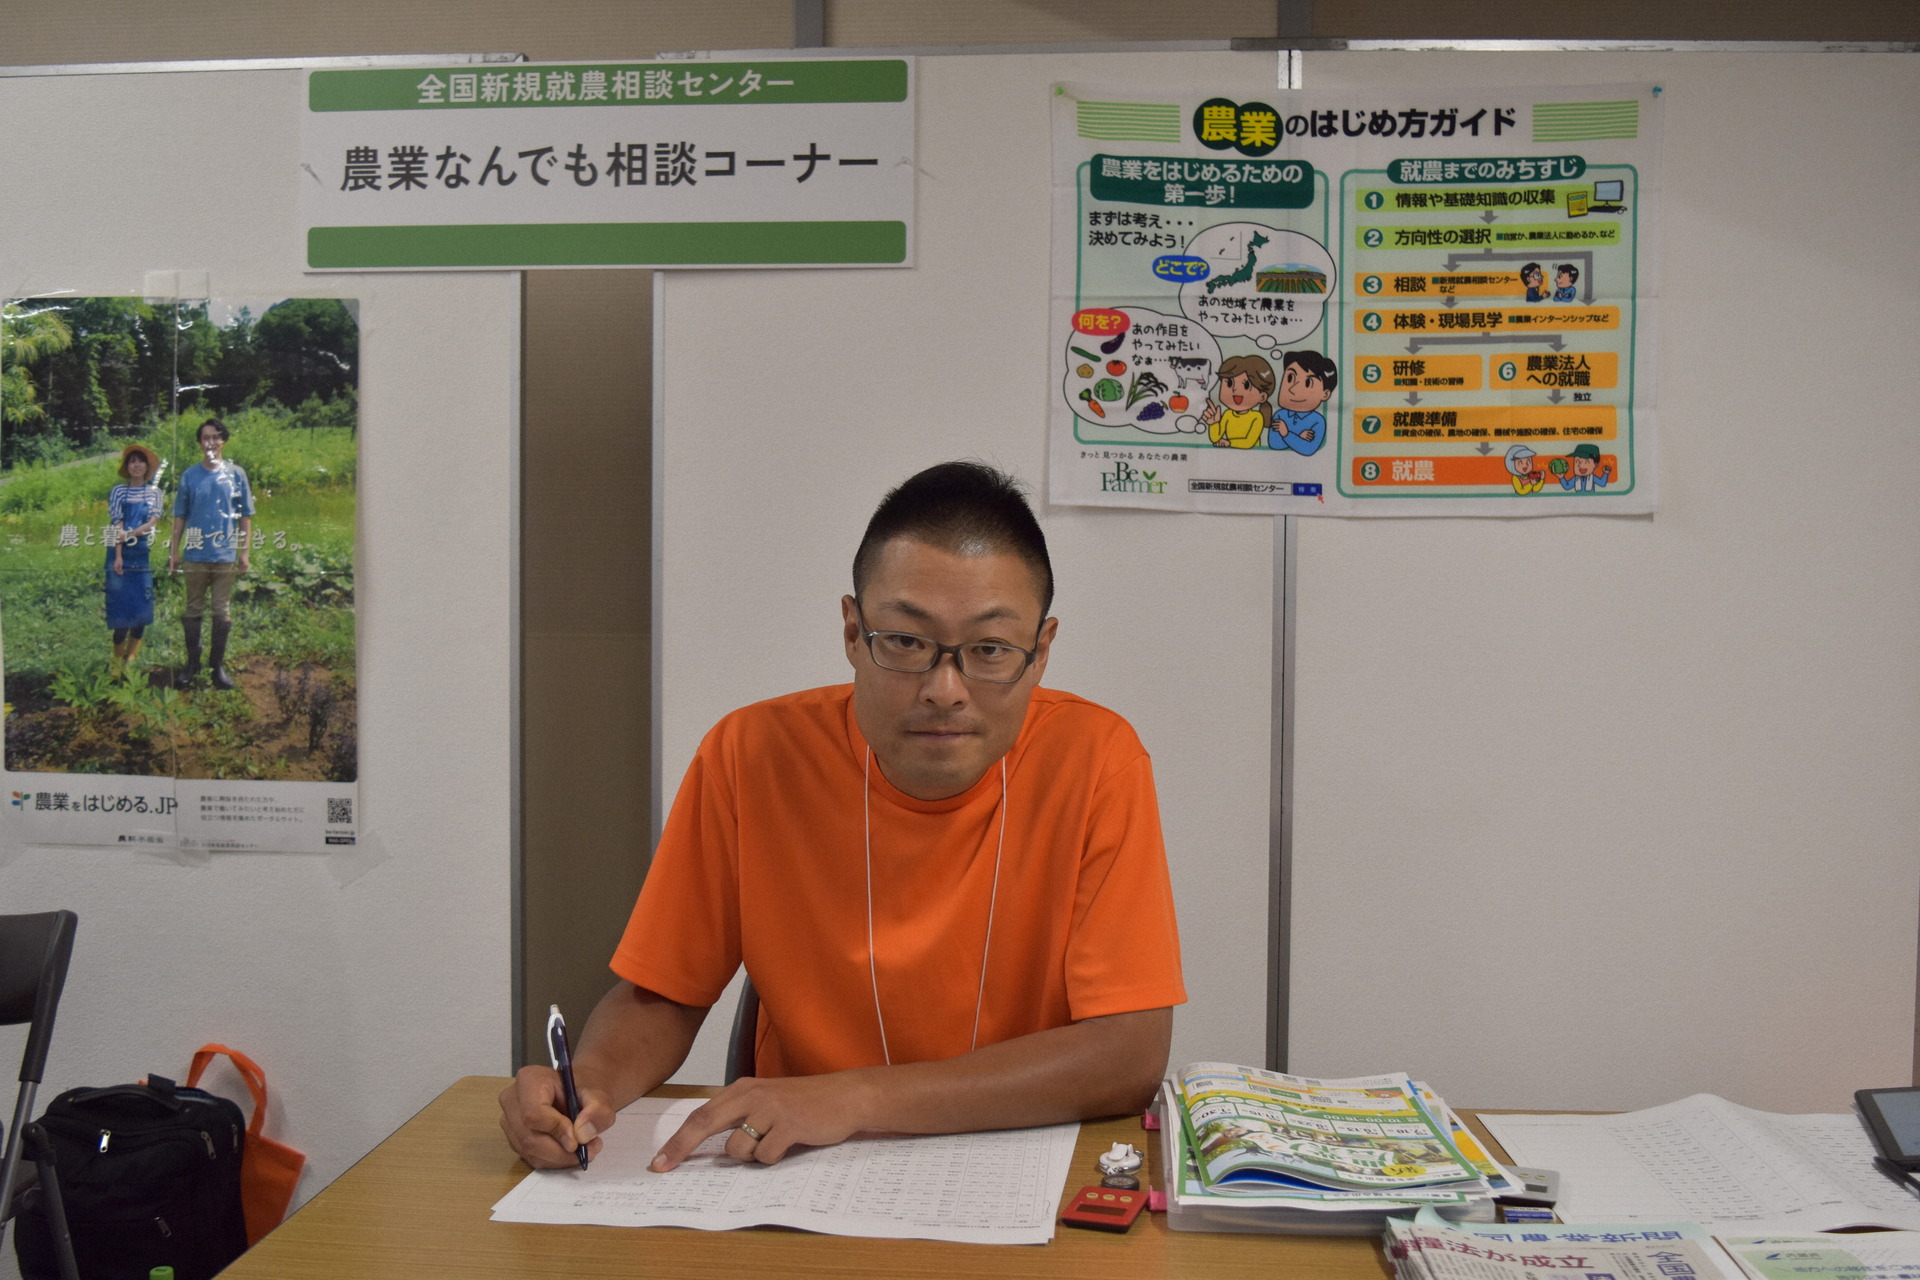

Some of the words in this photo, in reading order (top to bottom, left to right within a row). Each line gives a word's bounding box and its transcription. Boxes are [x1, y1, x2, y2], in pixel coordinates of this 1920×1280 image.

[416, 70, 795, 104] 全国新規就農相談センター
[1202, 106, 1516, 147] 農業のはじめ方ガイド
[340, 141, 879, 192] 農業なんでも相談コーナー
[1101, 158, 1303, 184] 農業をはじめるための
[1400, 158, 1578, 182] 就農までのみちすじ
[1164, 184, 1236, 204] 第一歩！
[1395, 190, 1556, 208] 情報や基礎知識の収集
[1088, 231, 1185, 248] 決めてみよう！
[1394, 229, 1491, 246] 方向性の選択
[1155, 260, 1207, 276] どこで？
[1394, 277, 1426, 293] 相談
[1198, 295, 1295, 311] あの地域で農業を
[1078, 313, 1122, 330] 何を？
[1394, 313, 1503, 329] 体験・現場見学
[1515, 314, 1609, 324] 農業インターンシップなど
[1132, 323, 1188, 337] あの作目を
[1132, 339, 1200, 351] やってみたい
[1393, 360, 1425, 376] 研修
[1526, 355, 1591, 371] 農業法人
[1526, 372, 1591, 387] への就職
[1393, 411, 1457, 427] 就農準備
[1115, 462, 1139, 481] Be
[1392, 461, 1435, 482] 就農
[1101, 472, 1168, 494] Farmer
[35, 792, 178, 815] 農業をはじめる.JP
